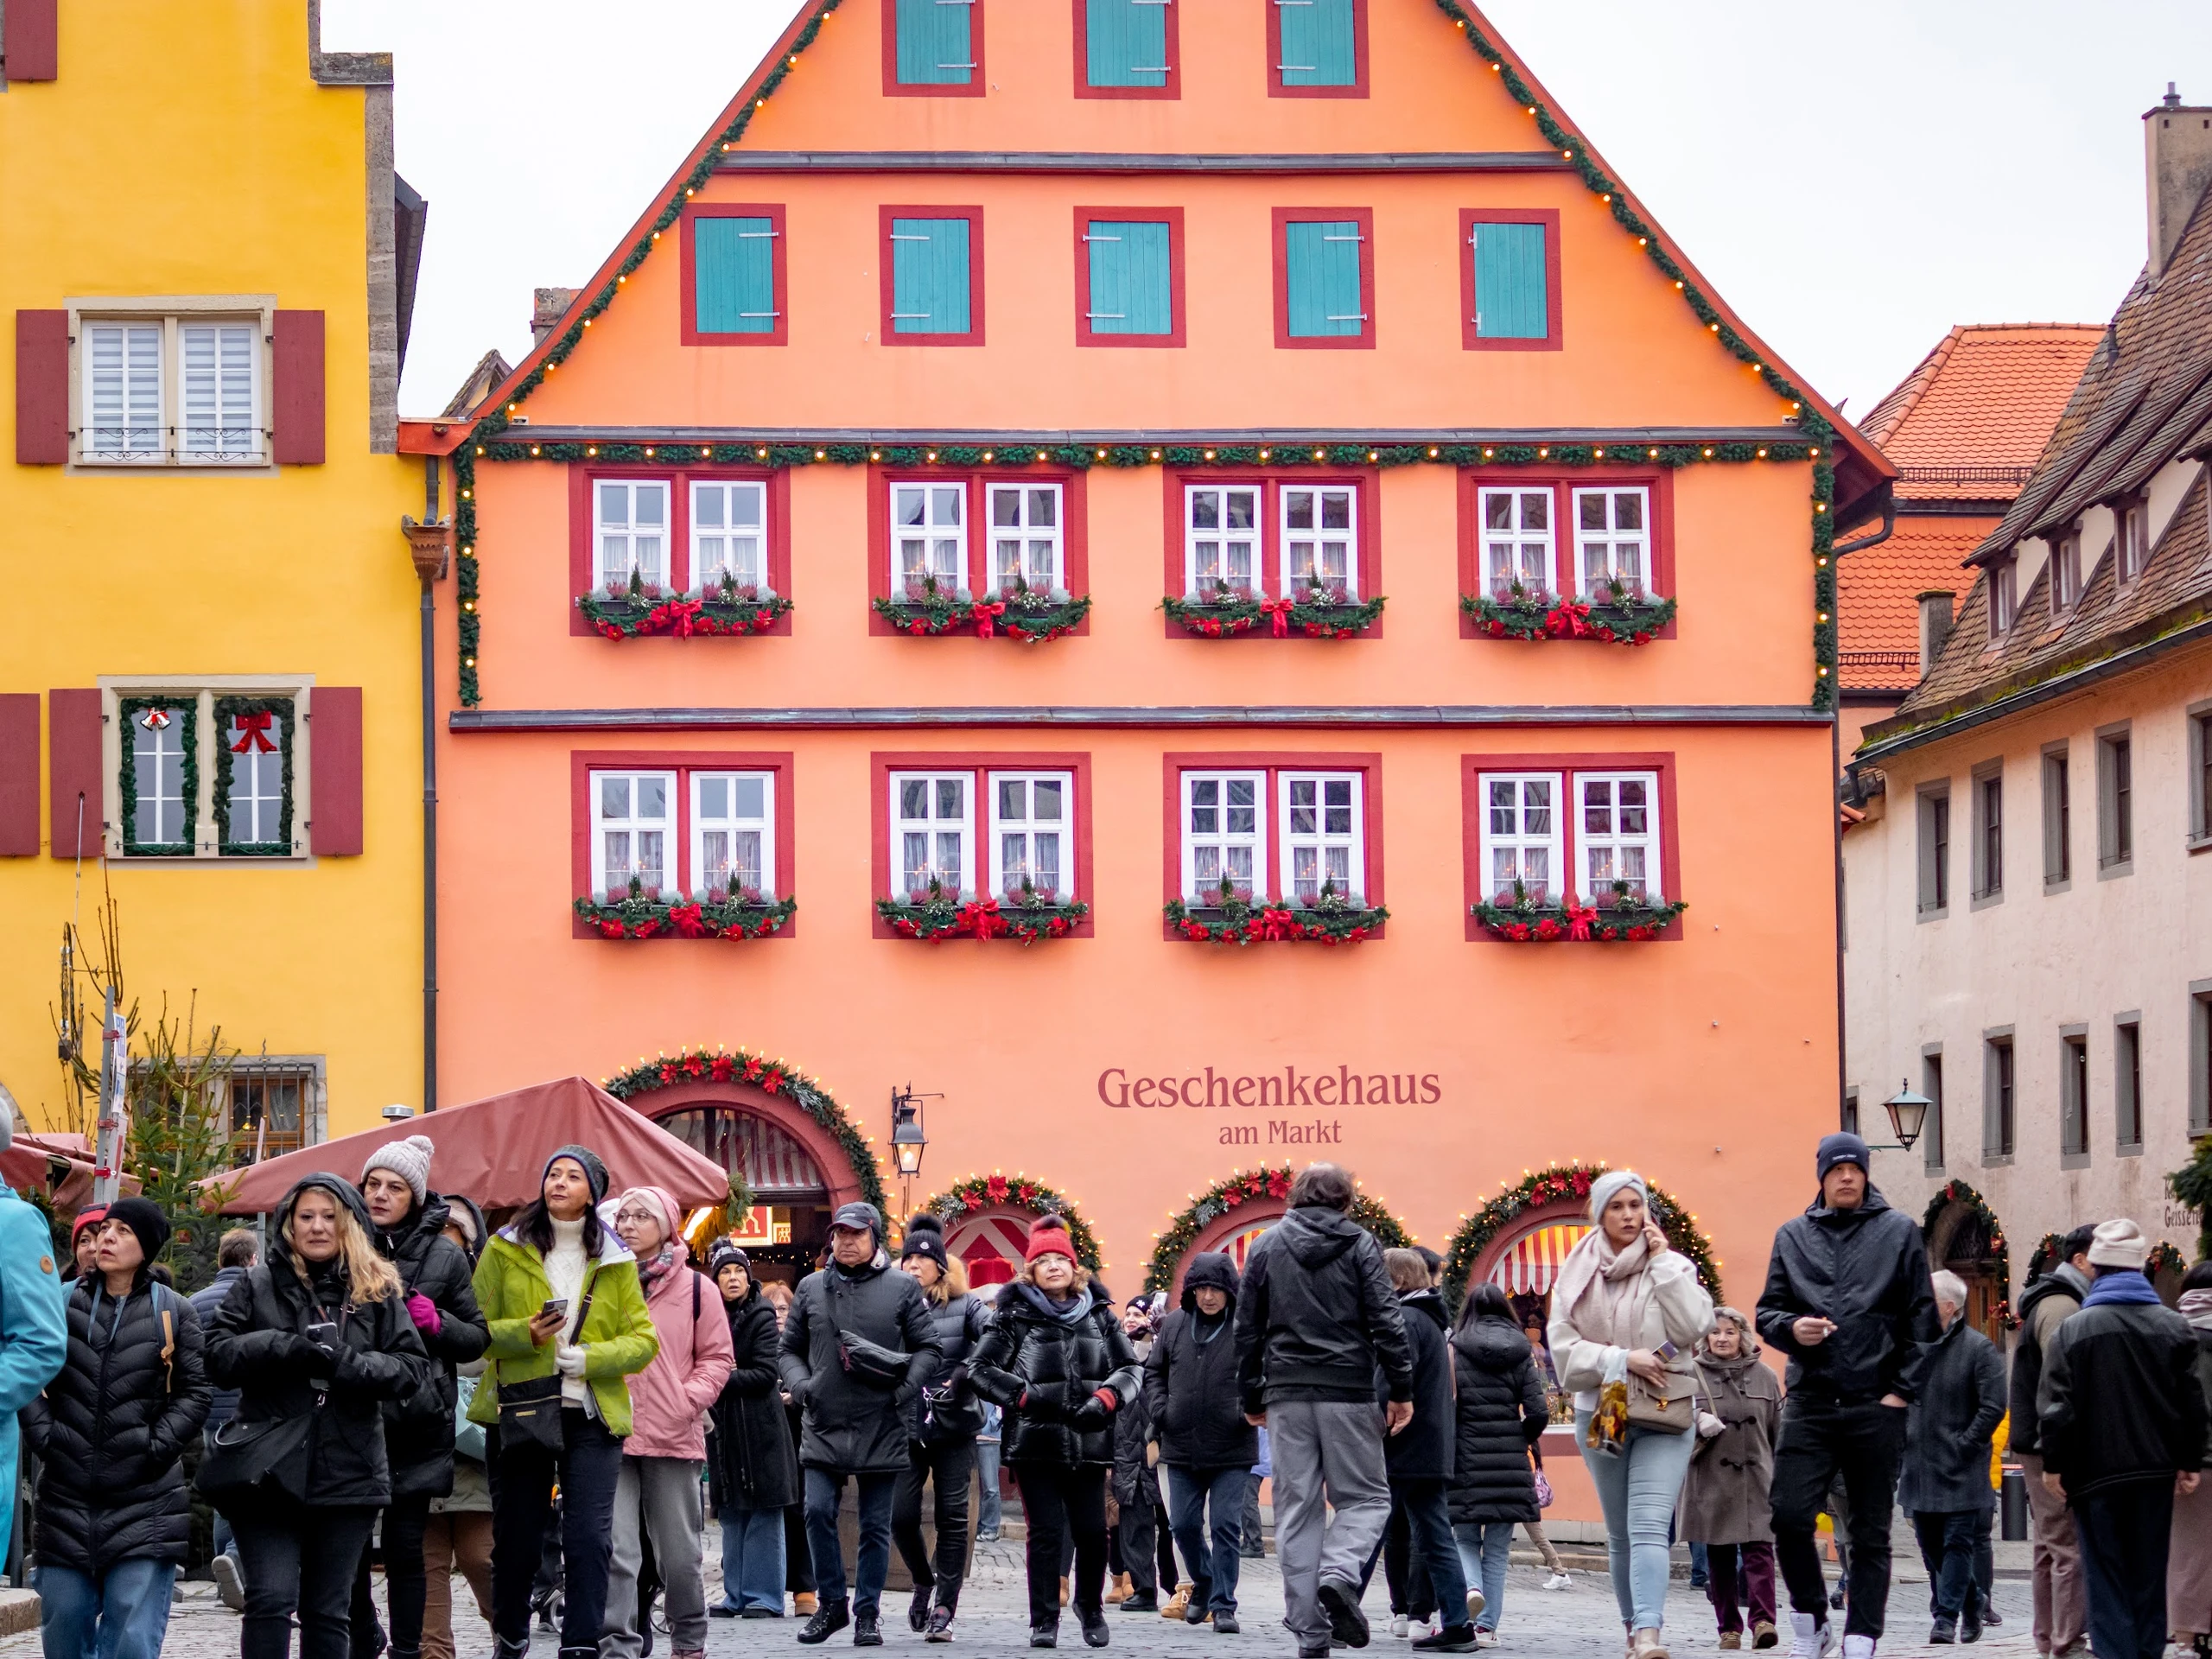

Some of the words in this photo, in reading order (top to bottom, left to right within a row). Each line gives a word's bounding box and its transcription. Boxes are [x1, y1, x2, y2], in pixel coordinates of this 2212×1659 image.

[1097, 1065, 1441, 1108] Geschenkehaus
[1219, 1125, 1259, 1145] am
[1268, 1120, 1342, 1144] Markt
[2164, 1205, 2202, 1228] Geissen
